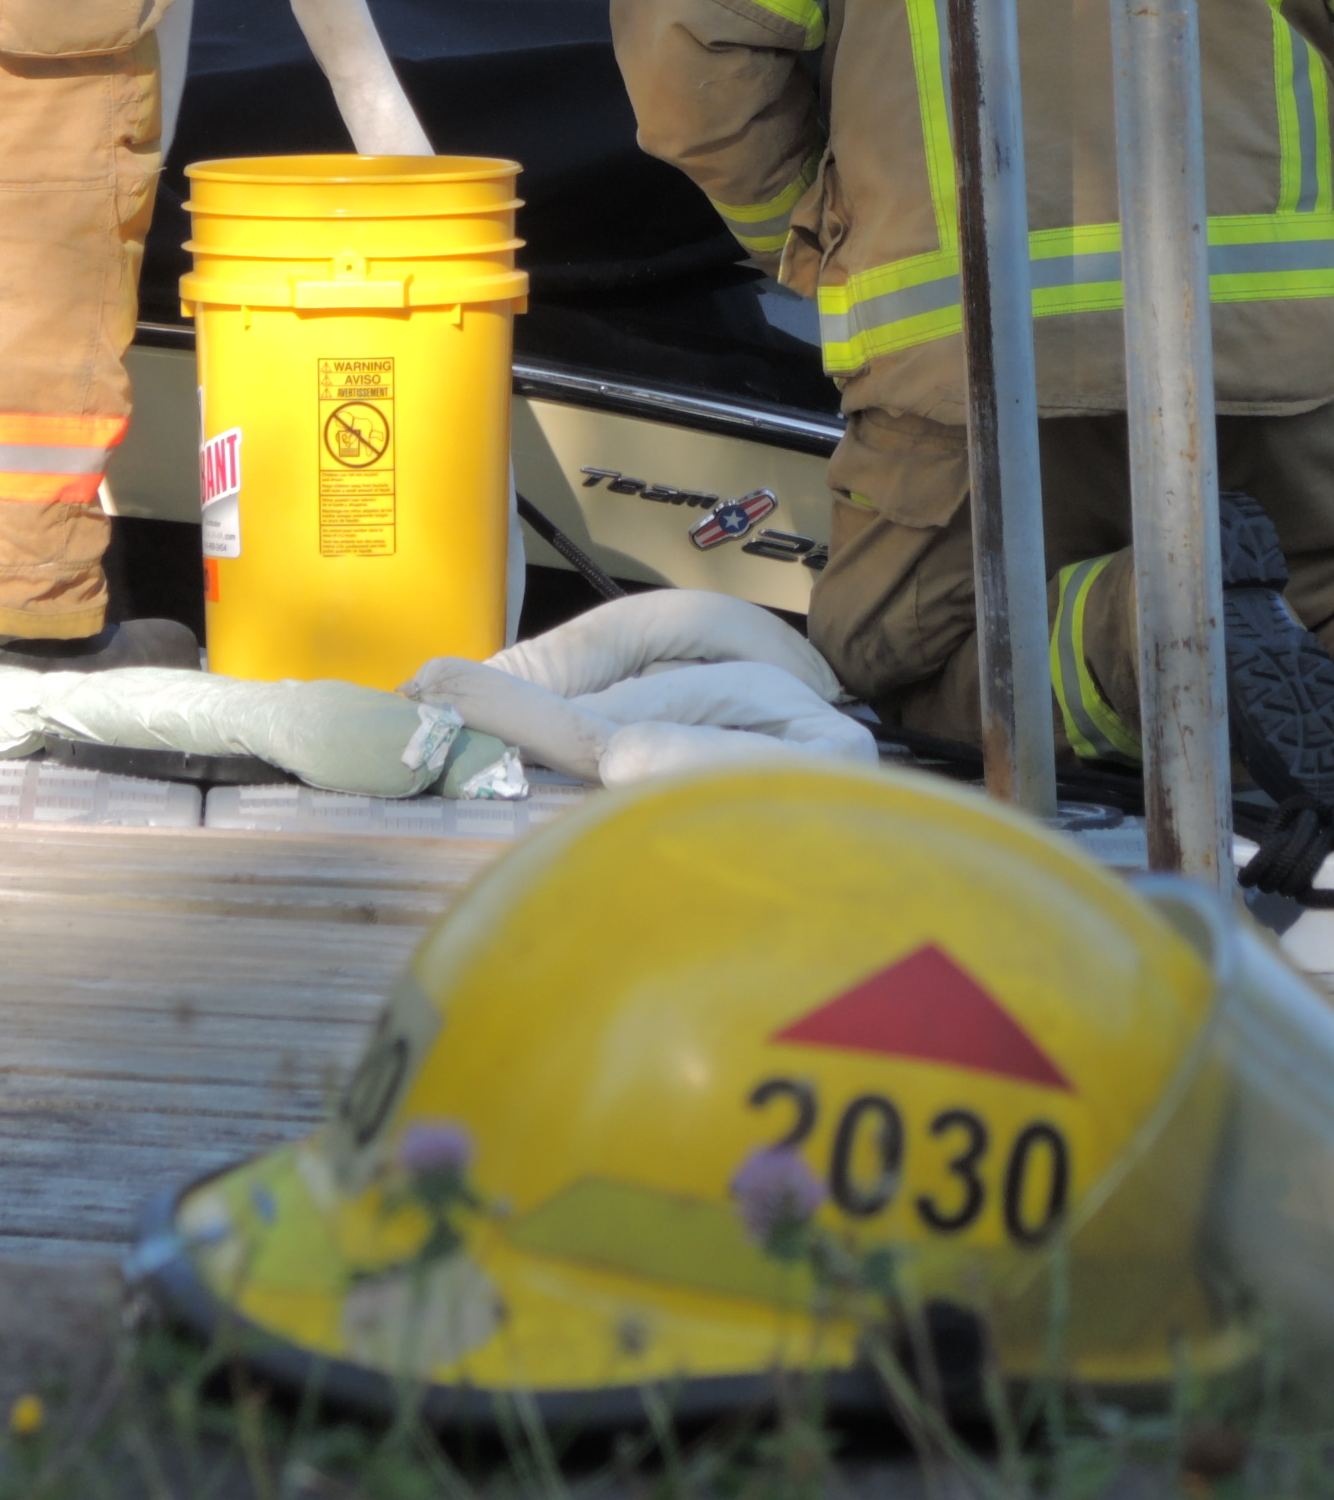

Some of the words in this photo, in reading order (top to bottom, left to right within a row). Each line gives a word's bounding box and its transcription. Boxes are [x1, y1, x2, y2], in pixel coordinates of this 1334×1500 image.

[333, 361, 392, 372] WARNING
[344, 374, 382, 386] AVISO
[580, 466, 719, 510] Team
[747, 1076, 1069, 1247] 2030
